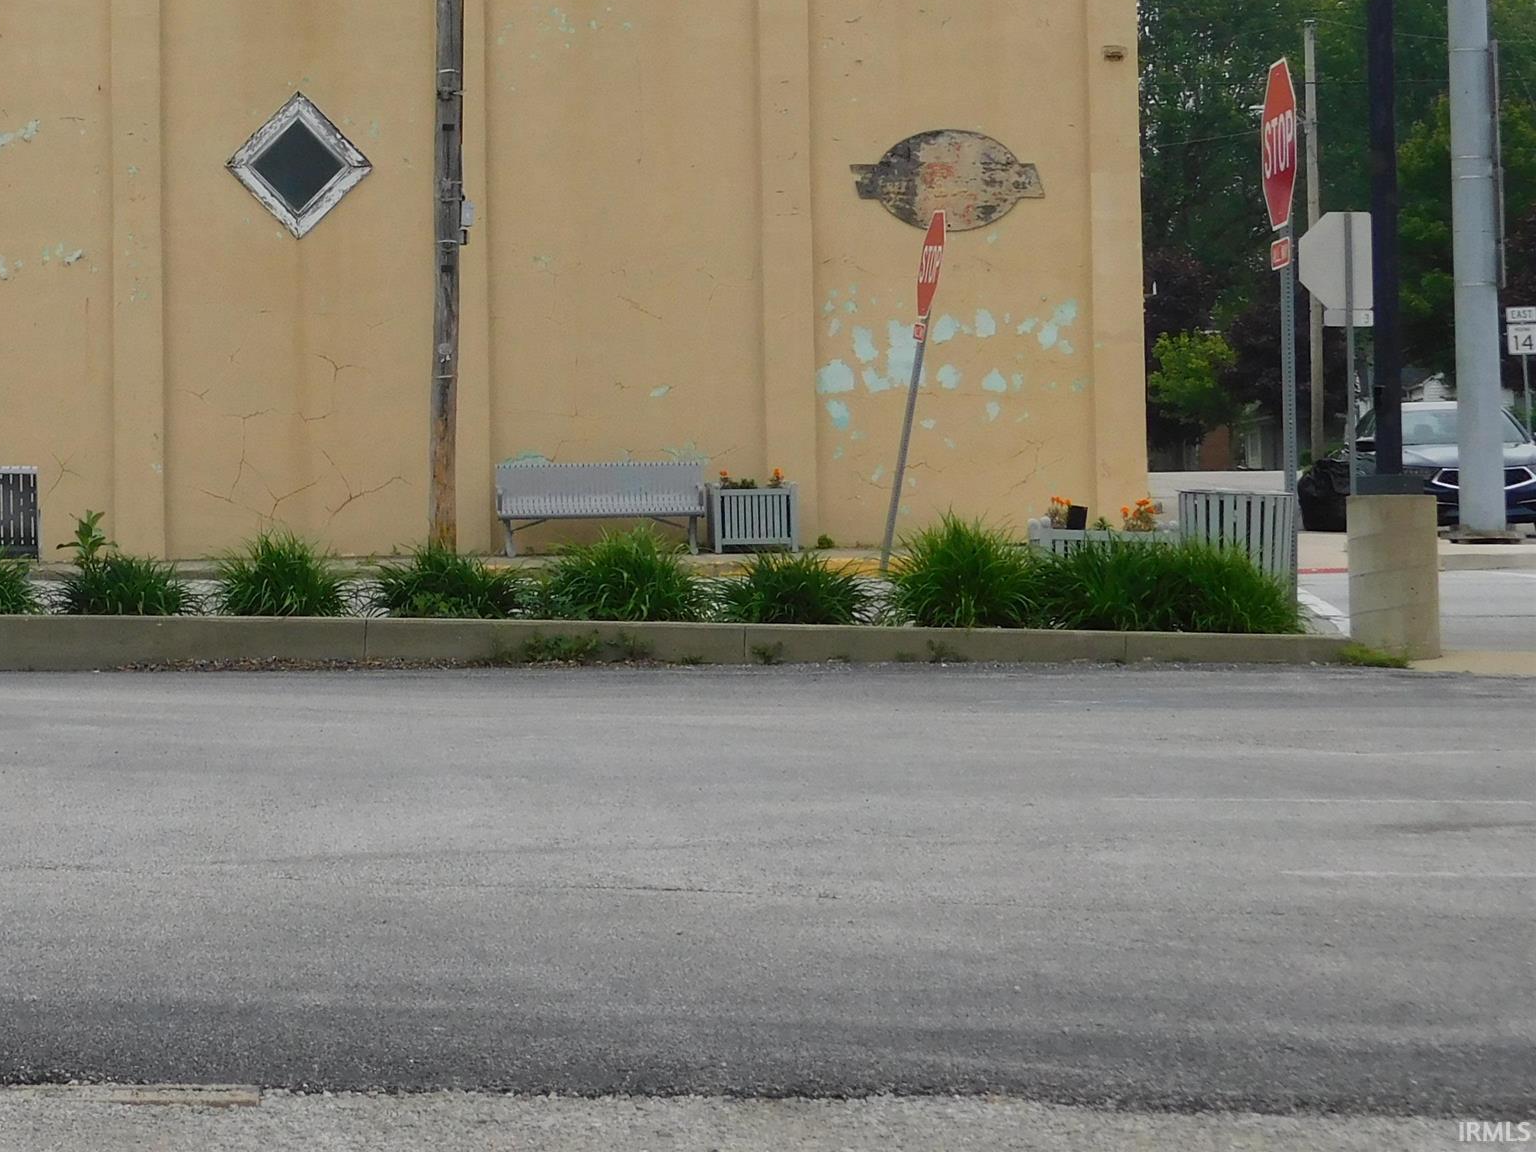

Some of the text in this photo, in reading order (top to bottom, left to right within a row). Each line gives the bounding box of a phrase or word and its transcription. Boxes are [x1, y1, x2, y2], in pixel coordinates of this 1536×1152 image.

[1265, 109, 1293, 179] STOP
[919, 245, 943, 283] STOP
[1511, 310, 1533, 319] EAST
[1513, 334, 1533, 351] 14
